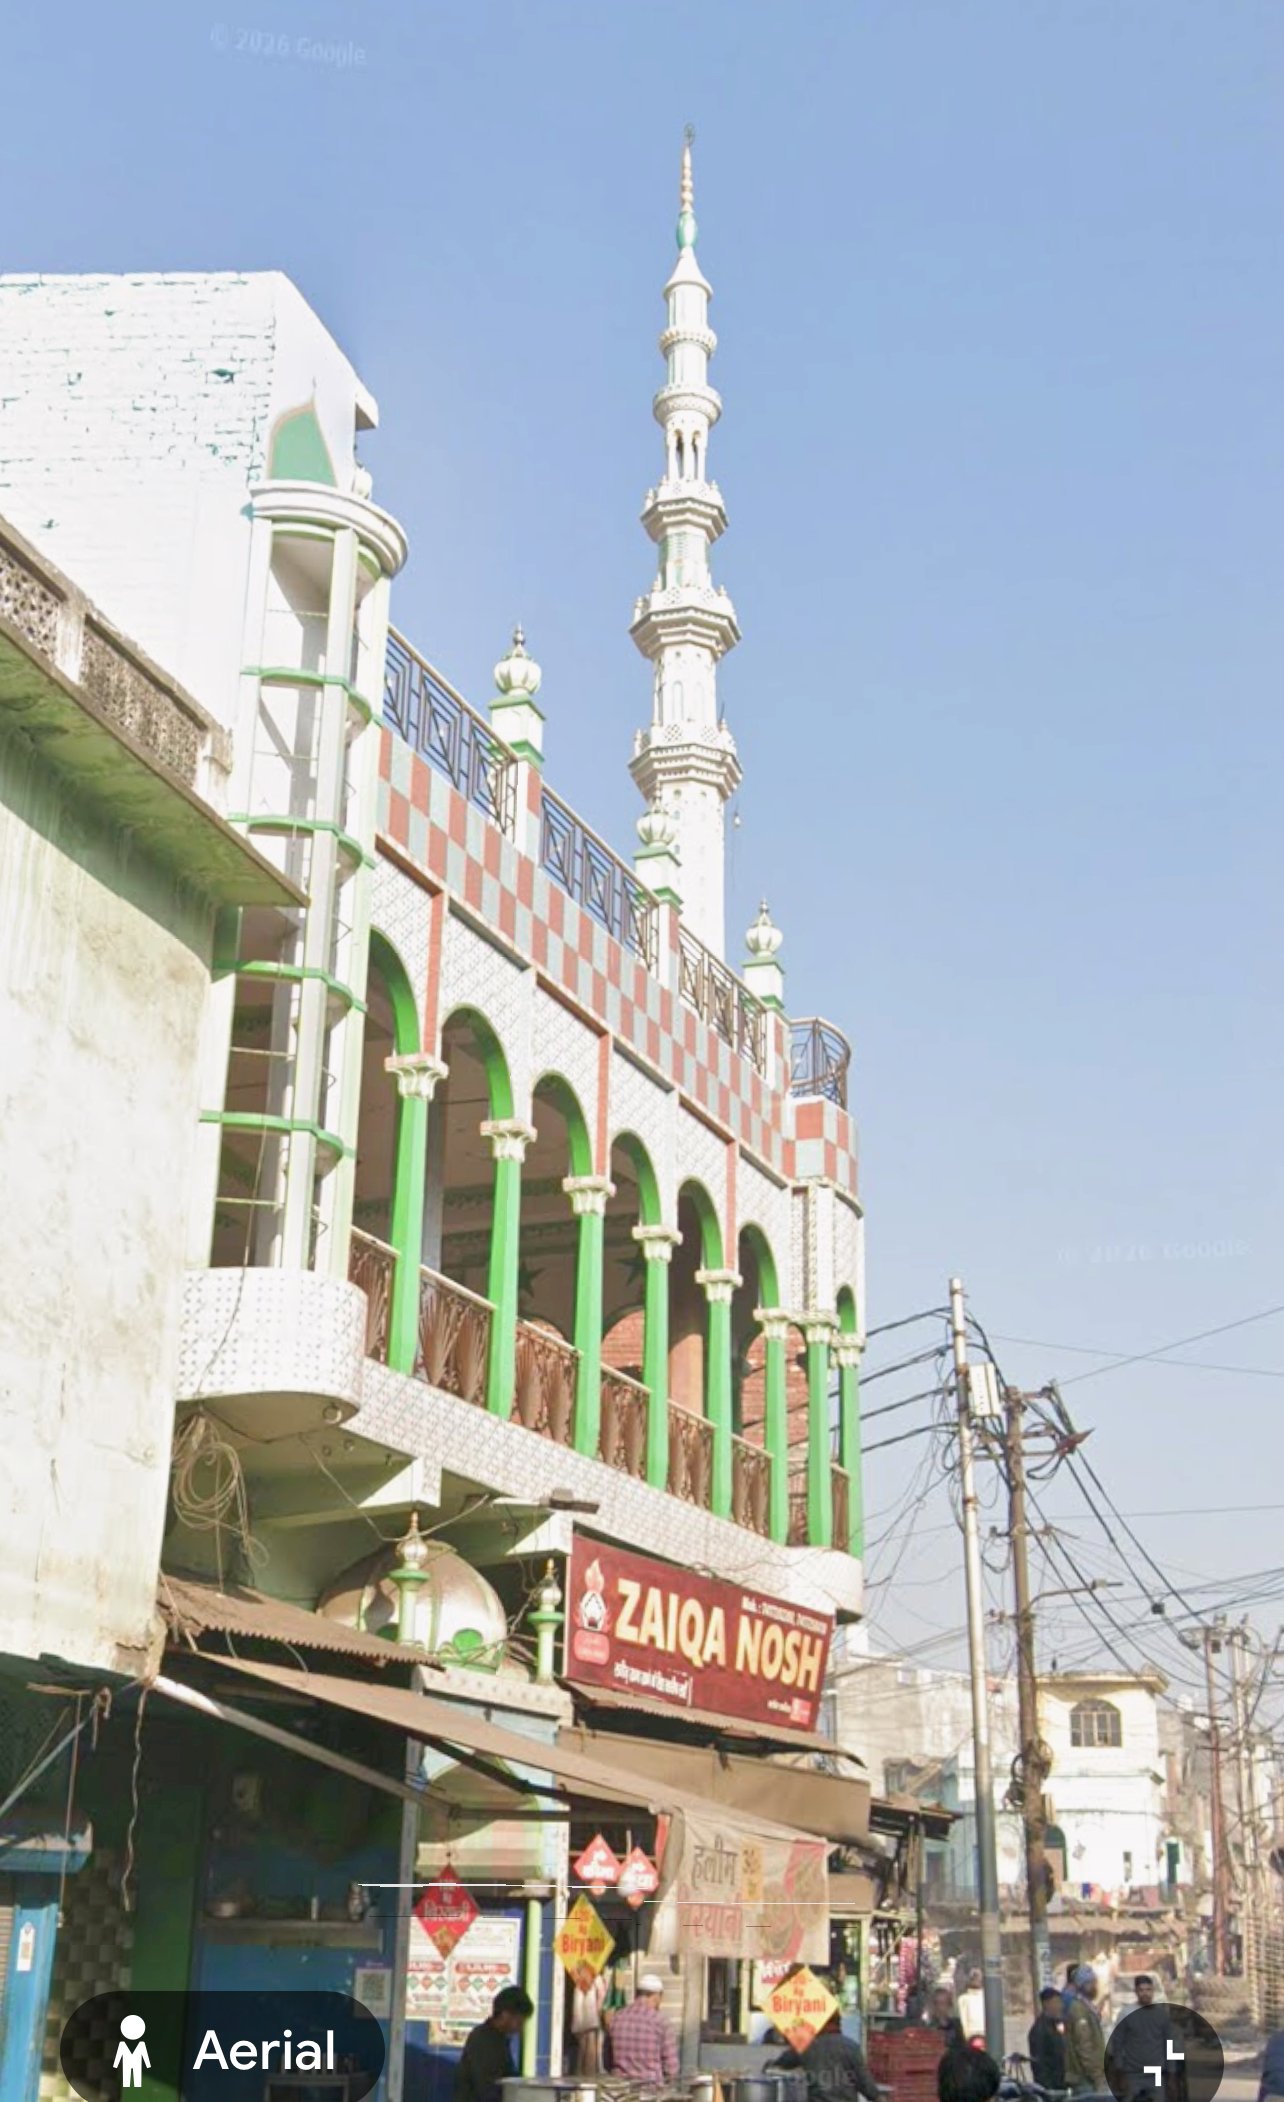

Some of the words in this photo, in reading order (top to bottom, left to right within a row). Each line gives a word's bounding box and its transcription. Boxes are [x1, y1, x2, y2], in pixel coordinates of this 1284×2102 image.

[614, 1577, 727, 1668] ZAIQA
[735, 1616, 823, 1692] NOSH
[691, 1834, 738, 1891] हलीम
[562, 1936, 605, 1958] Biryani
[773, 1995, 827, 2016] Biryani
